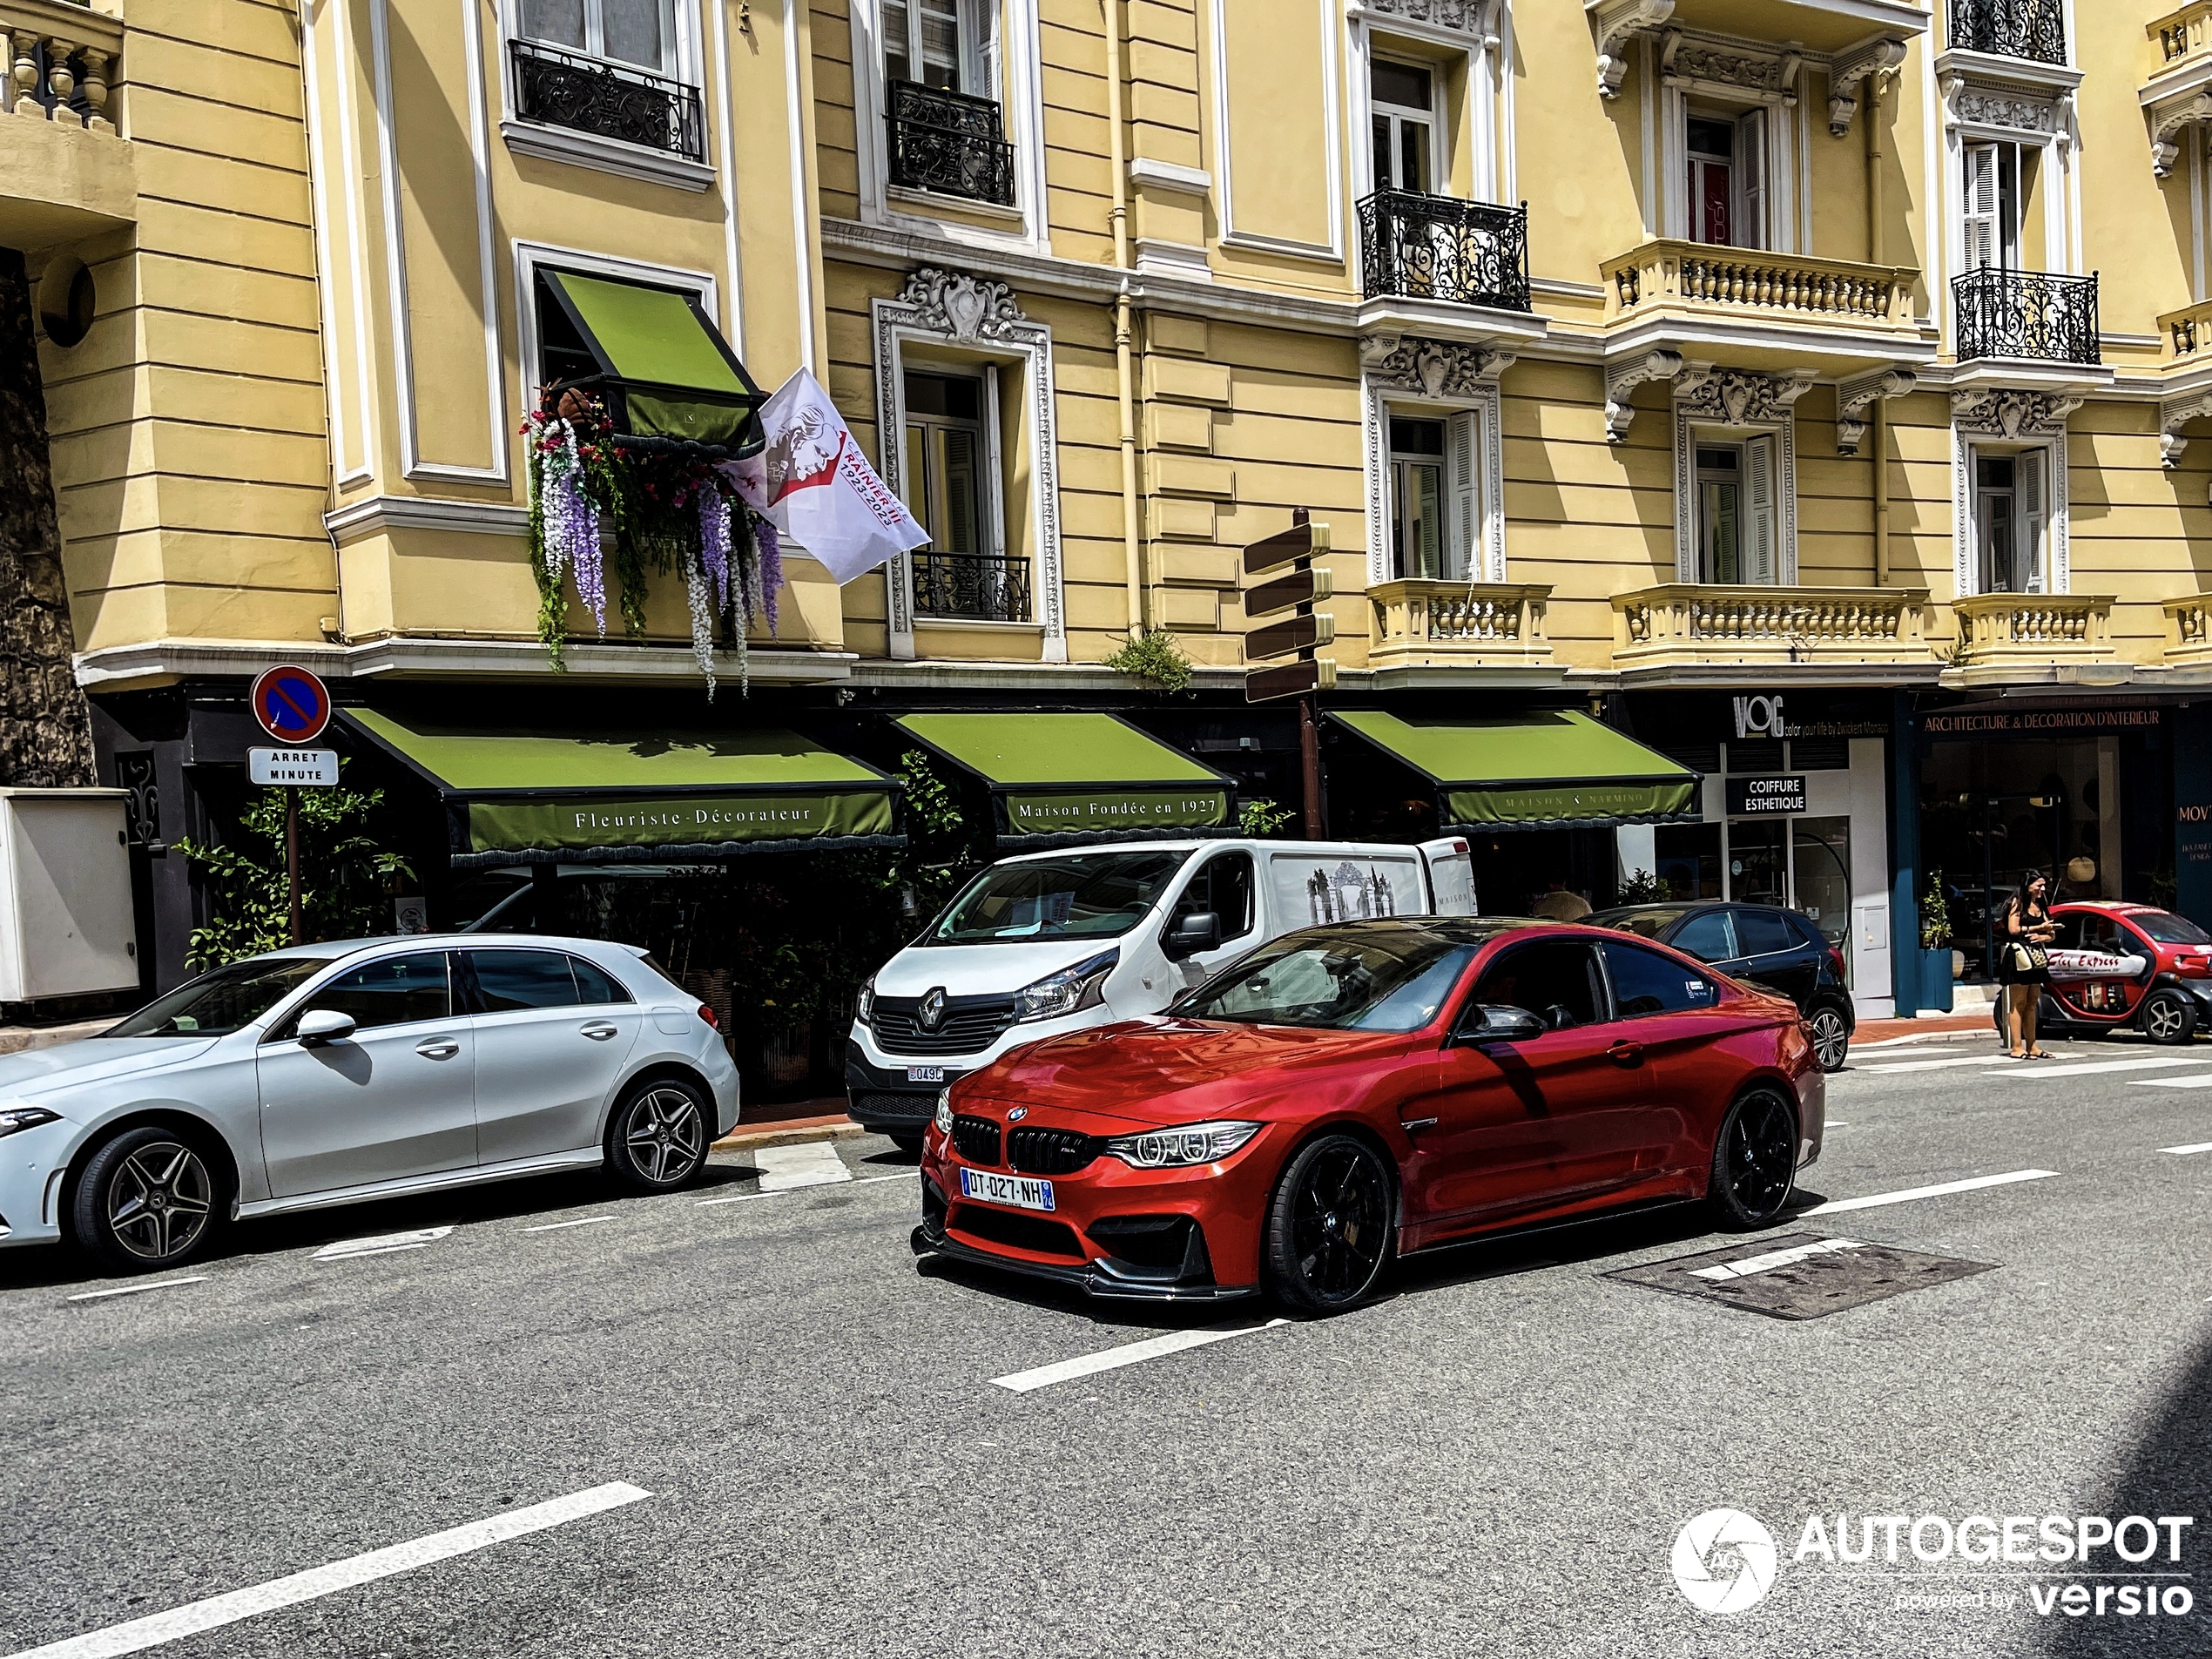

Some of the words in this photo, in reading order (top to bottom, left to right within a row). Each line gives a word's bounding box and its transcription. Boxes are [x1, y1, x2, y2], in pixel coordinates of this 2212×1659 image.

[845, 454, 889, 506] RAINIER
[888, 509, 901, 524] III
[847, 442, 909, 521] CENTENAIRE
[840, 463, 893, 526] 1923-2023
[1733, 695, 1784, 738] VOG
[1924, 714, 2010, 732] ARCHITECTURE
[2013, 716, 2021, 729] &
[2024, 712, 2096, 729] DECORATION
[2097, 711, 2160, 727] D'INTERIEUR
[1784, 722, 1801, 737] color
[1802, 725, 1817, 738] your
[1828, 721, 1836, 738] by
[1864, 721, 1889, 733] Monaco
[271, 752, 319, 763] ARRET
[270, 770, 322, 780] MINUTE
[1750, 779, 1800, 793] COIFFURE
[1506, 796, 1562, 808] MAISON
[1588, 792, 1643, 805] NARMINO
[1745, 796, 1804, 811] ESTHETIQUE
[1018, 804, 1080, 818] Maison
[1089, 801, 1147, 816] Fondée
[1155, 804, 1172, 814] en
[1182, 799, 1217, 813] 1927
[1438, 894, 1468, 906] MAISON
[2078, 955, 2120, 968] Express
[916, 1068, 941, 1080] 049C
